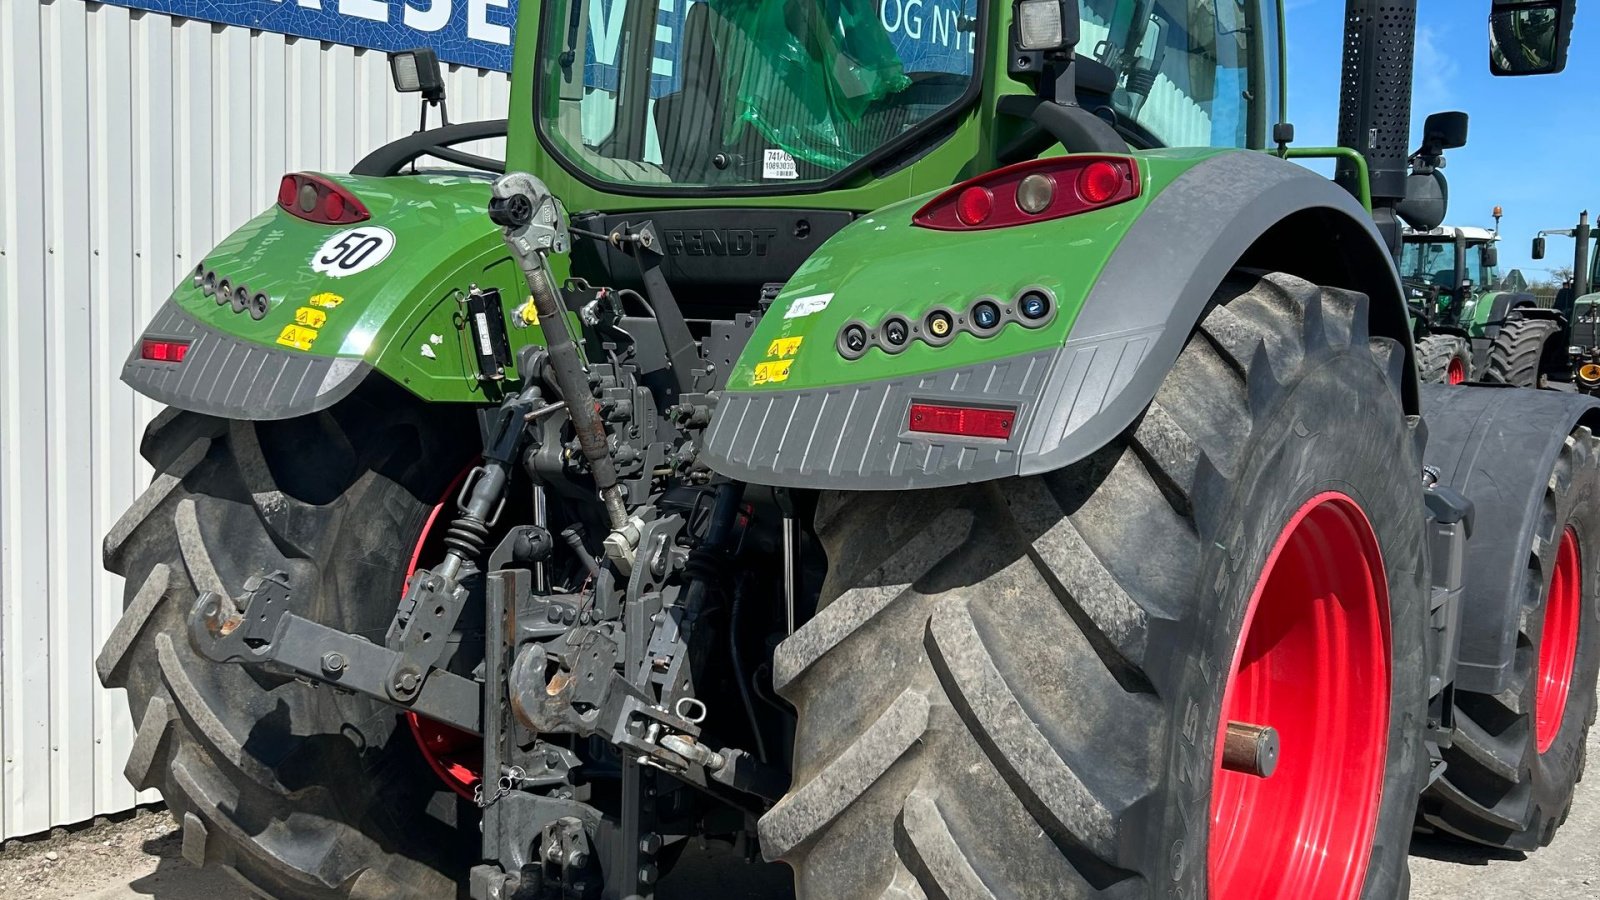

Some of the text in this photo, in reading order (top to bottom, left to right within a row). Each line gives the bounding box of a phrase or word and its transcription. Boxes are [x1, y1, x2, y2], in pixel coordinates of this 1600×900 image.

[880, 0, 923, 39] OG
[321, 232, 383, 270] 50
[663, 228, 777, 257] FENDT
